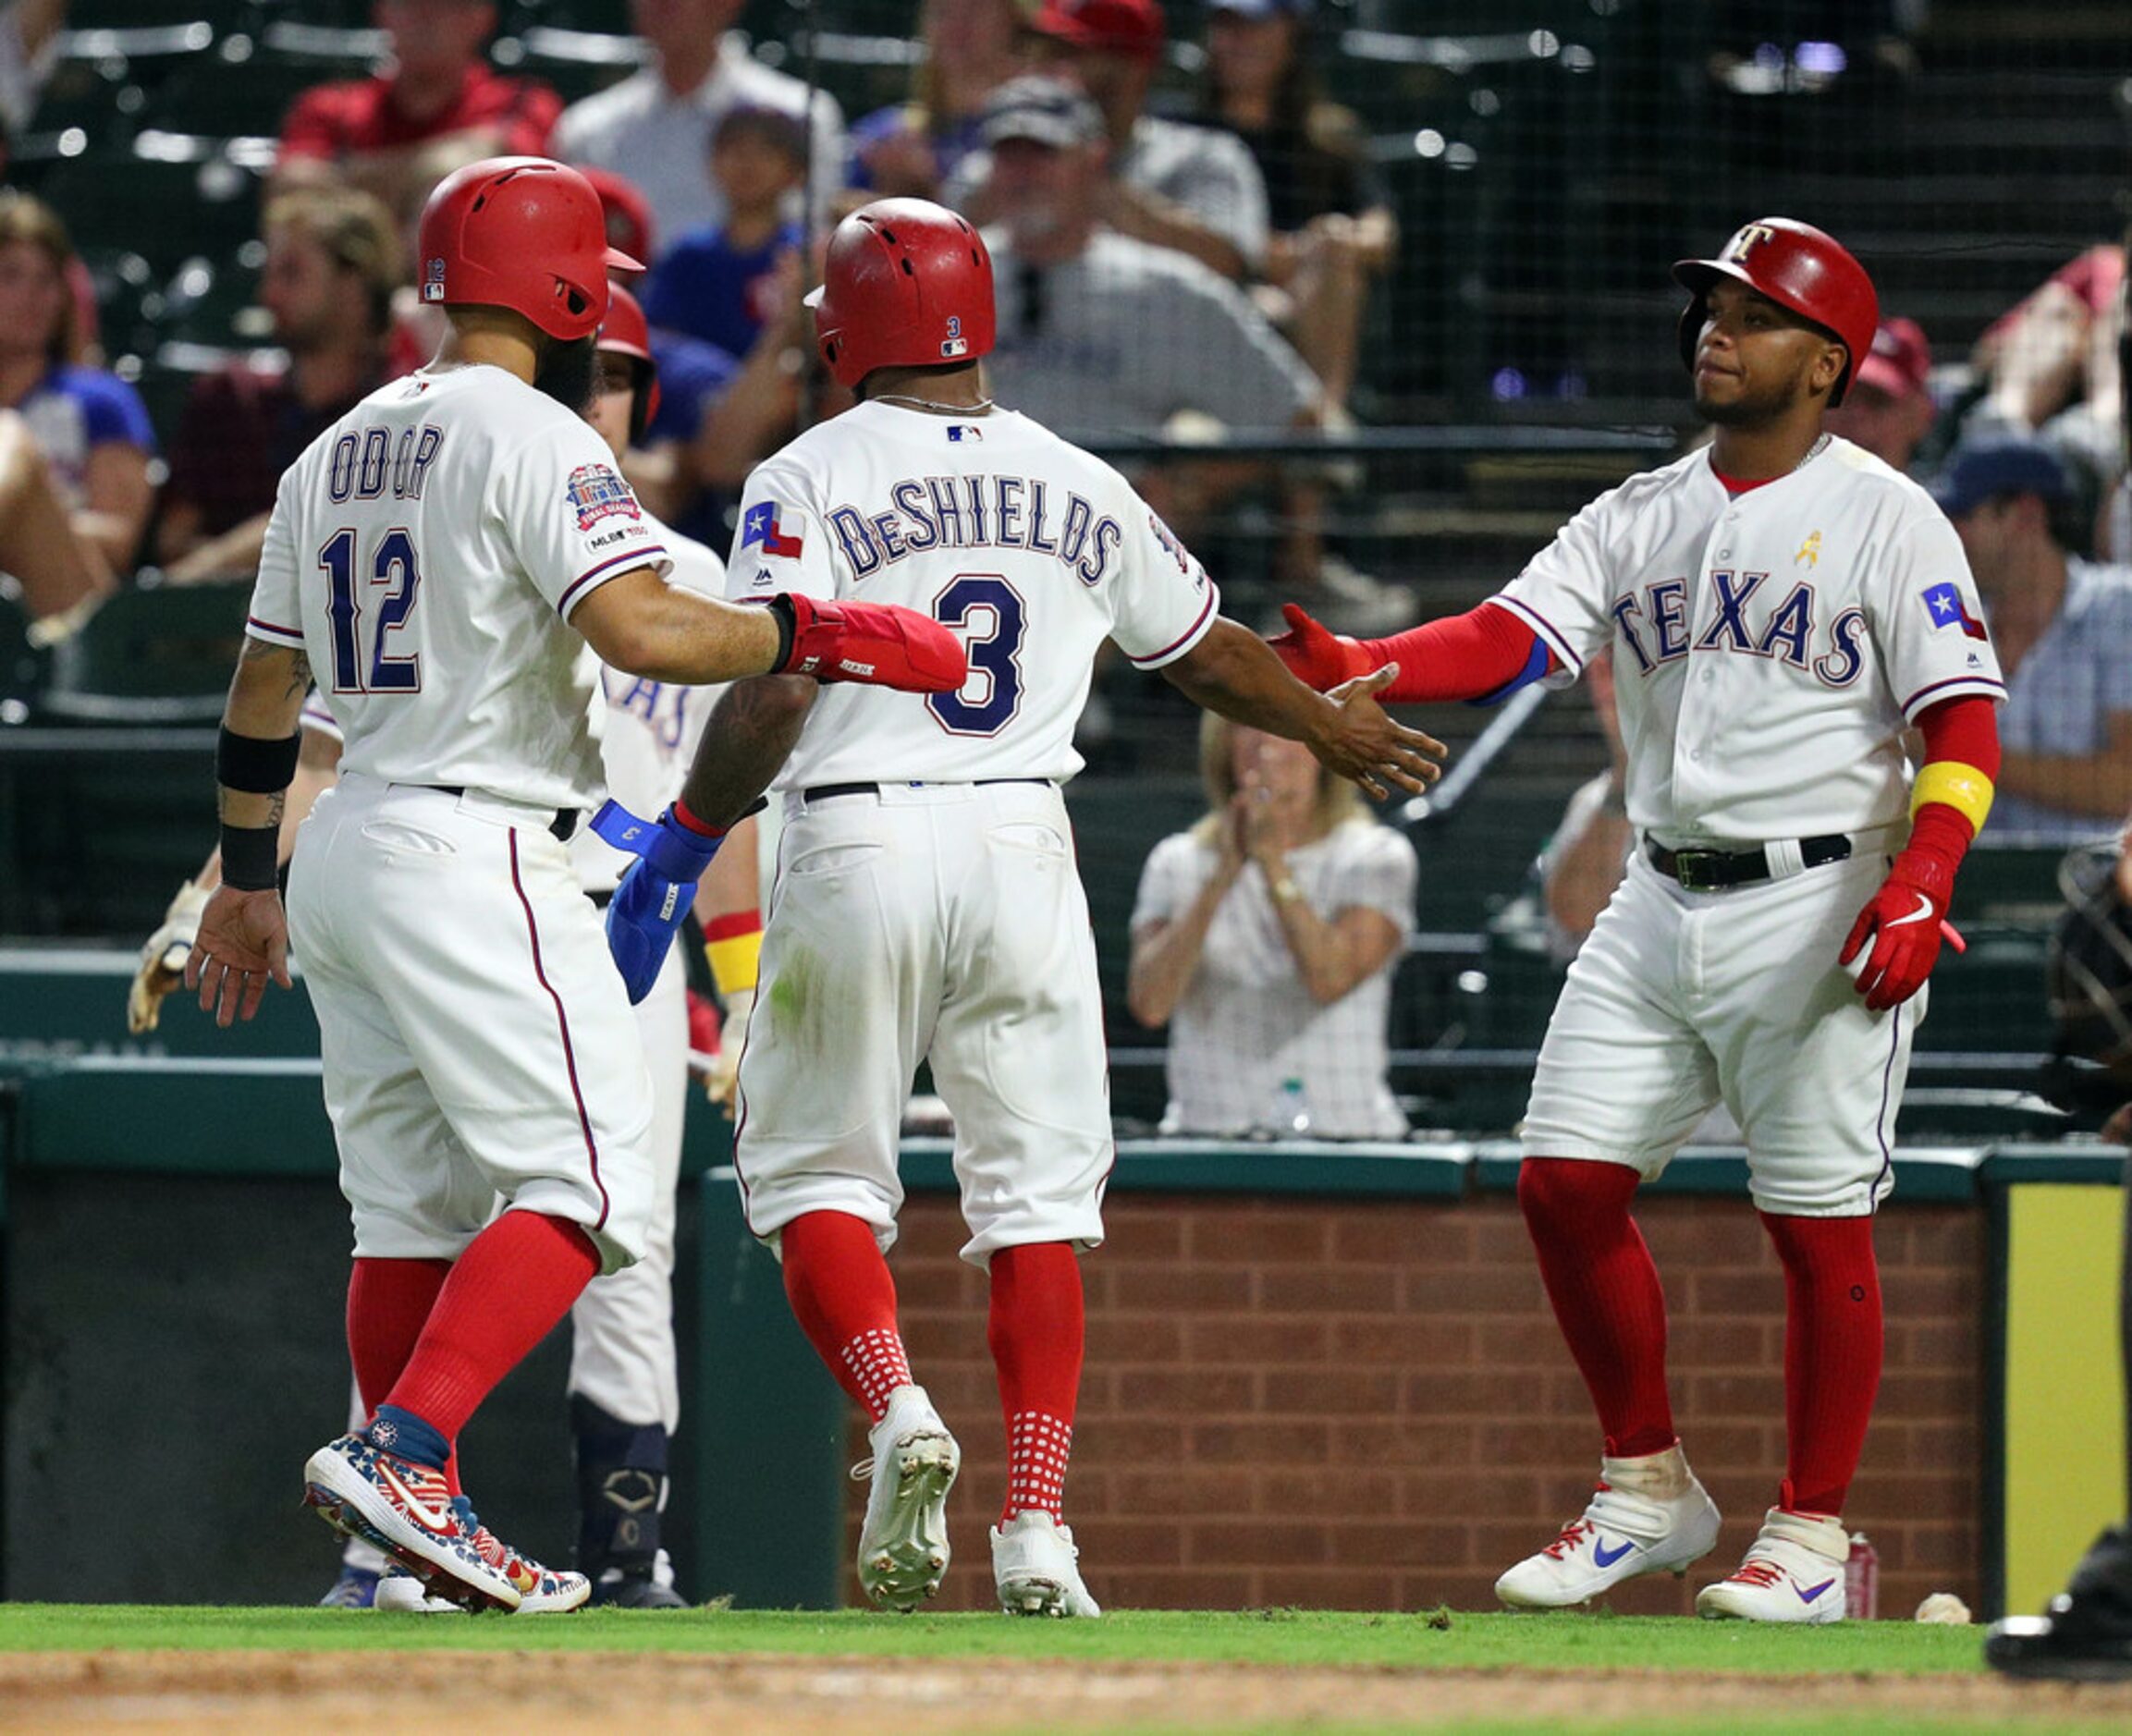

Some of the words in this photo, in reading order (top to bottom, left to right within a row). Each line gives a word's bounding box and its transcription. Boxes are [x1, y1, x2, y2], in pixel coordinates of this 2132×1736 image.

[1731, 225, 1774, 264] T
[947, 315, 961, 338] 3
[328, 425, 444, 504] ODOR
[318, 527, 421, 694] 12
[925, 573, 1029, 738] 3
[1612, 569, 1867, 689] TEXAS
